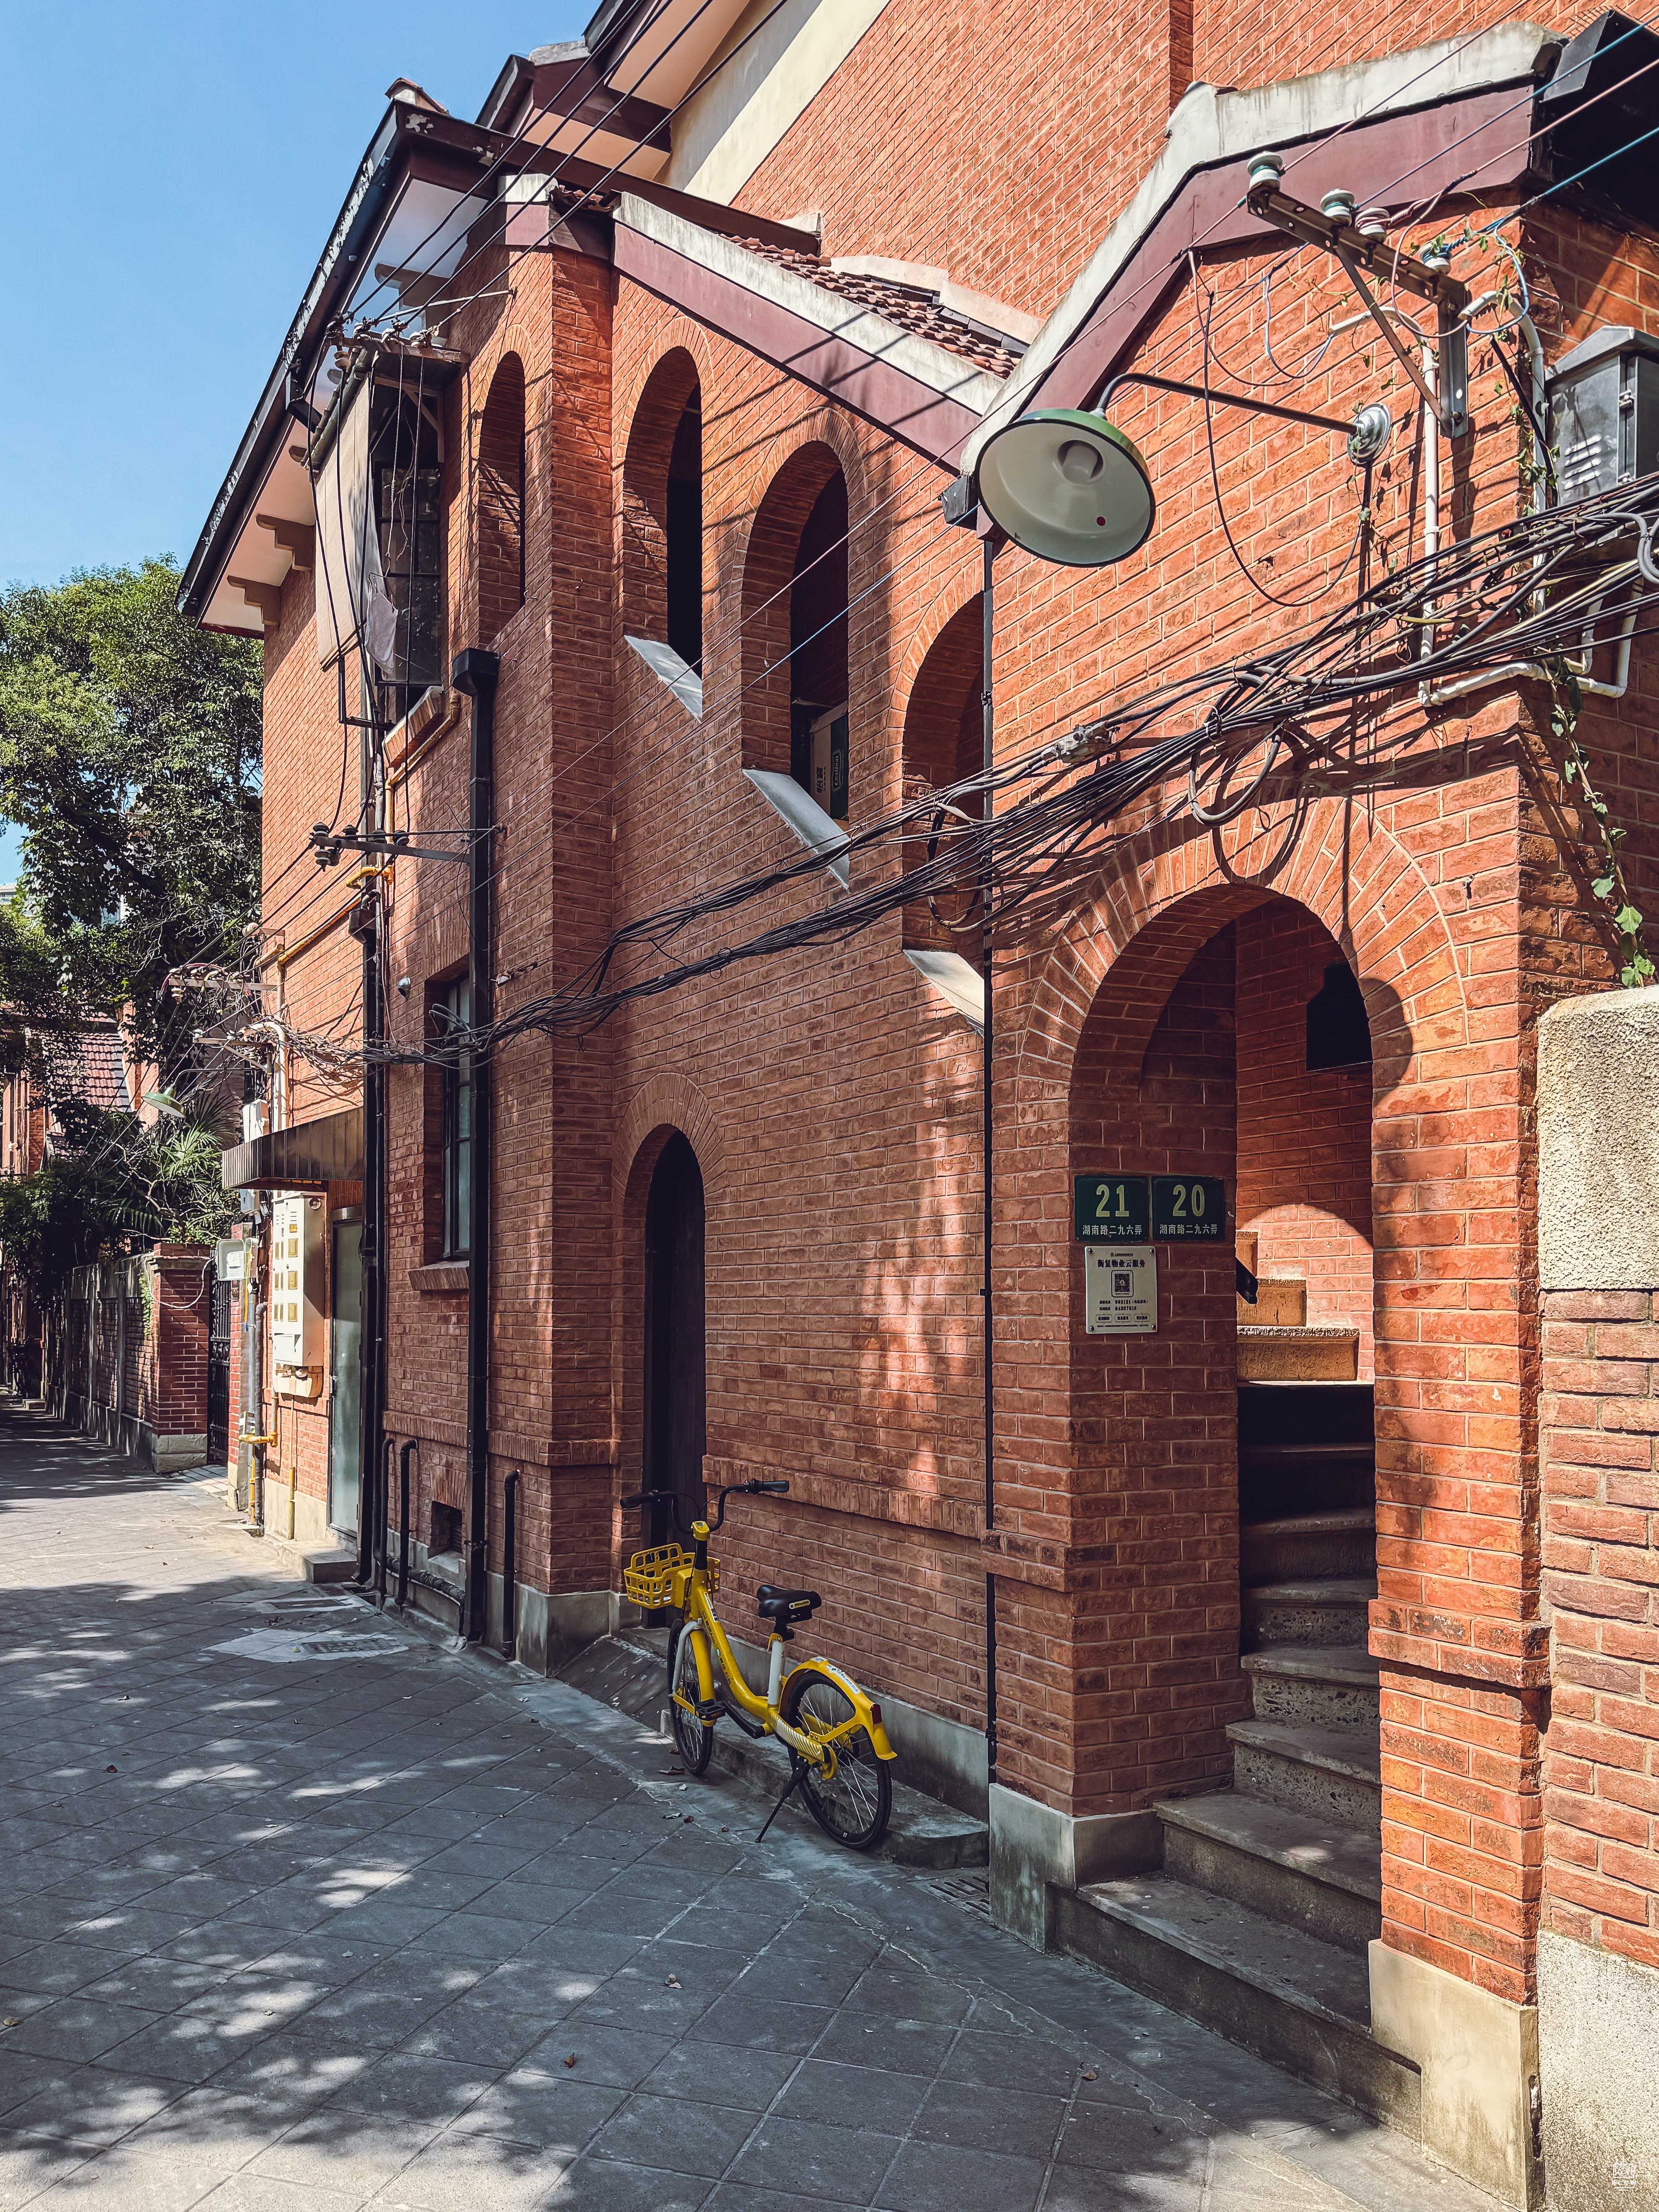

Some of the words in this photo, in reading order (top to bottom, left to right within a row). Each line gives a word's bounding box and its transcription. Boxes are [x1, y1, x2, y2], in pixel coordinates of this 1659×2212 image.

[1096, 1184, 1129, 1217] 21
[1173, 1184, 1205, 1217] 20
[1083, 1224, 1142, 1235] 湖南路二九六弄
[1159, 1224, 1218, 1234] 湖南路二九六弄
